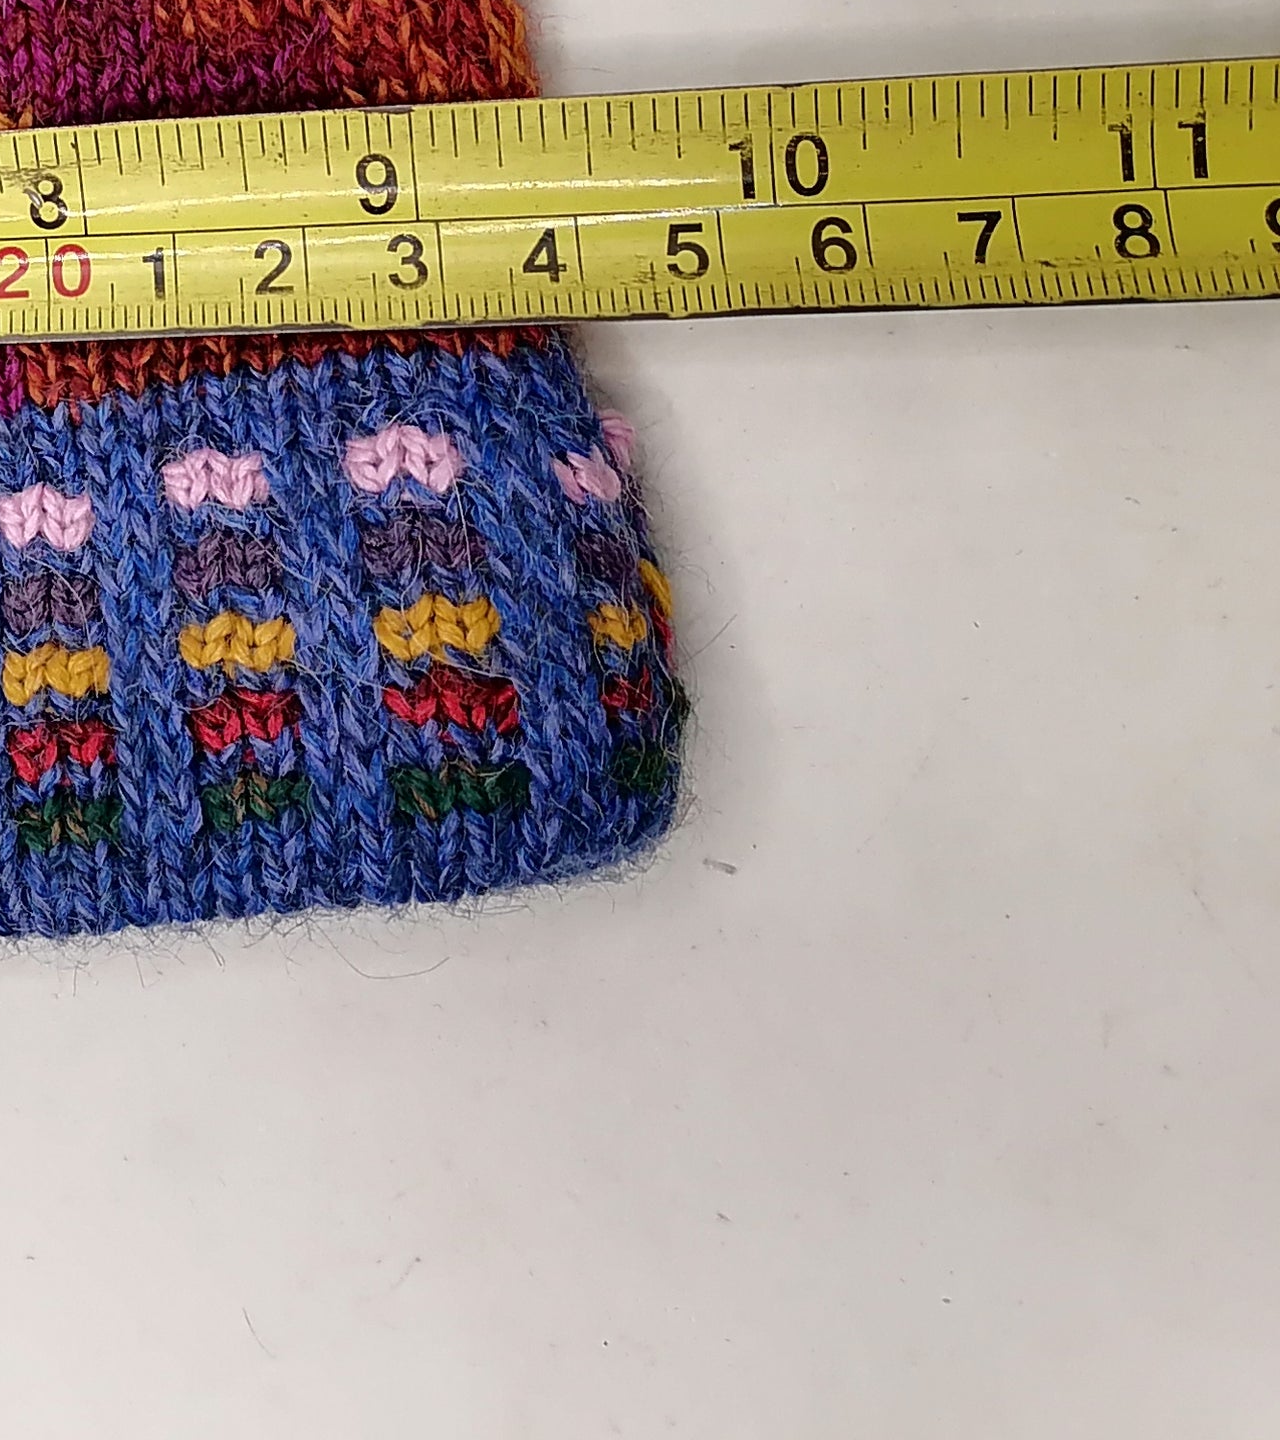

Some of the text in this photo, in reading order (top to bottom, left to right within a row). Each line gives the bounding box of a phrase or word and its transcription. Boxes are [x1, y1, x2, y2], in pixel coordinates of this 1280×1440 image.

[28, 173, 68, 230] 8
[354, 153, 399, 215] 9
[727, 133, 830, 200] 10
[1107, 113, 1210, 182] 11
[142, 245, 165, 300] 1
[253, 239, 295, 296] 2
[386, 233, 429, 290] 3
[522, 226, 567, 283] 4
[666, 221, 710, 281] 5
[810, 216, 858, 272] 6
[956, 210, 1003, 265] 7
[1112, 203, 1161, 259] 8
